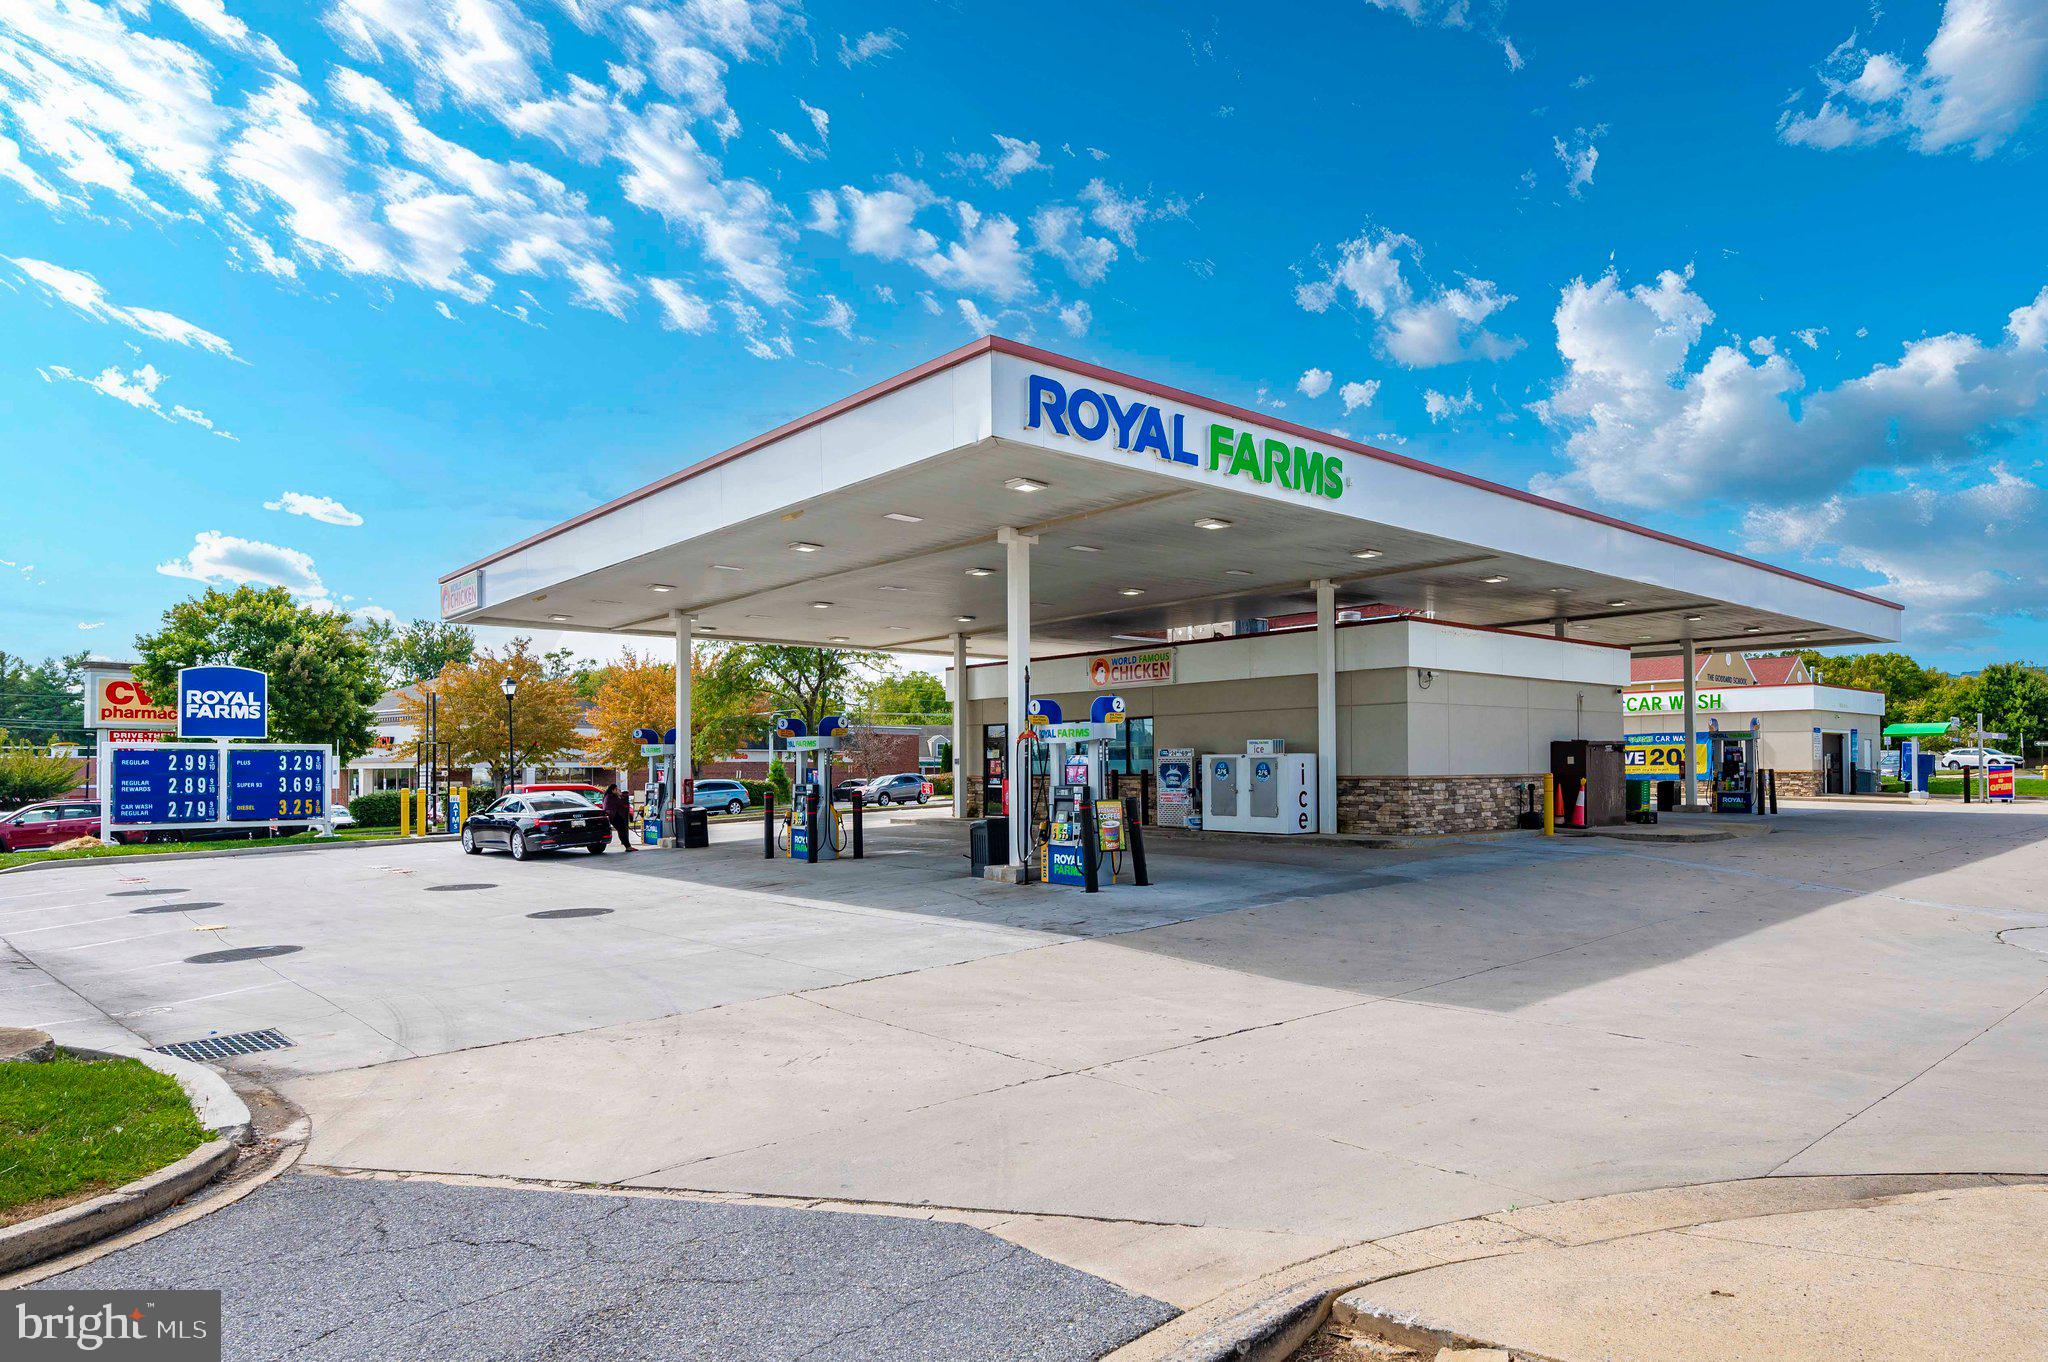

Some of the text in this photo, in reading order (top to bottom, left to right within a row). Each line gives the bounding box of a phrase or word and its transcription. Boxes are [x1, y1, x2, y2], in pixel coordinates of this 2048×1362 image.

[1027, 374, 1343, 499] ROYAL FARMS
[451, 585, 476, 608] CHICKEN
[1112, 652, 1170, 666] WORLD FAMOUS
[1112, 662, 1170, 682] CHICKEN
[106, 681, 153, 705] CV
[186, 690, 260, 706] ROYAL
[1032, 703, 1036, 712] 1
[1116, 701, 1121, 709] 2
[1626, 694, 1722, 712] CAR WSH
[101, 706, 177, 720] pharmac
[186, 704, 260, 719] FARMS
[1058, 728, 1090, 738] FARMS
[1254, 745, 1264, 753] ice
[168, 755, 206, 770] 2.99
[279, 755, 313, 770] 3.29
[1625, 748, 1685, 766] VE 20
[168, 778, 206, 793] 2.89
[279, 777, 313, 792] 3.69
[1299, 763, 1308, 830] ice
[168, 801, 206, 817] 2.79
[279, 799, 313, 815] 3.25
[1054, 854, 1082, 865] ROYAL
